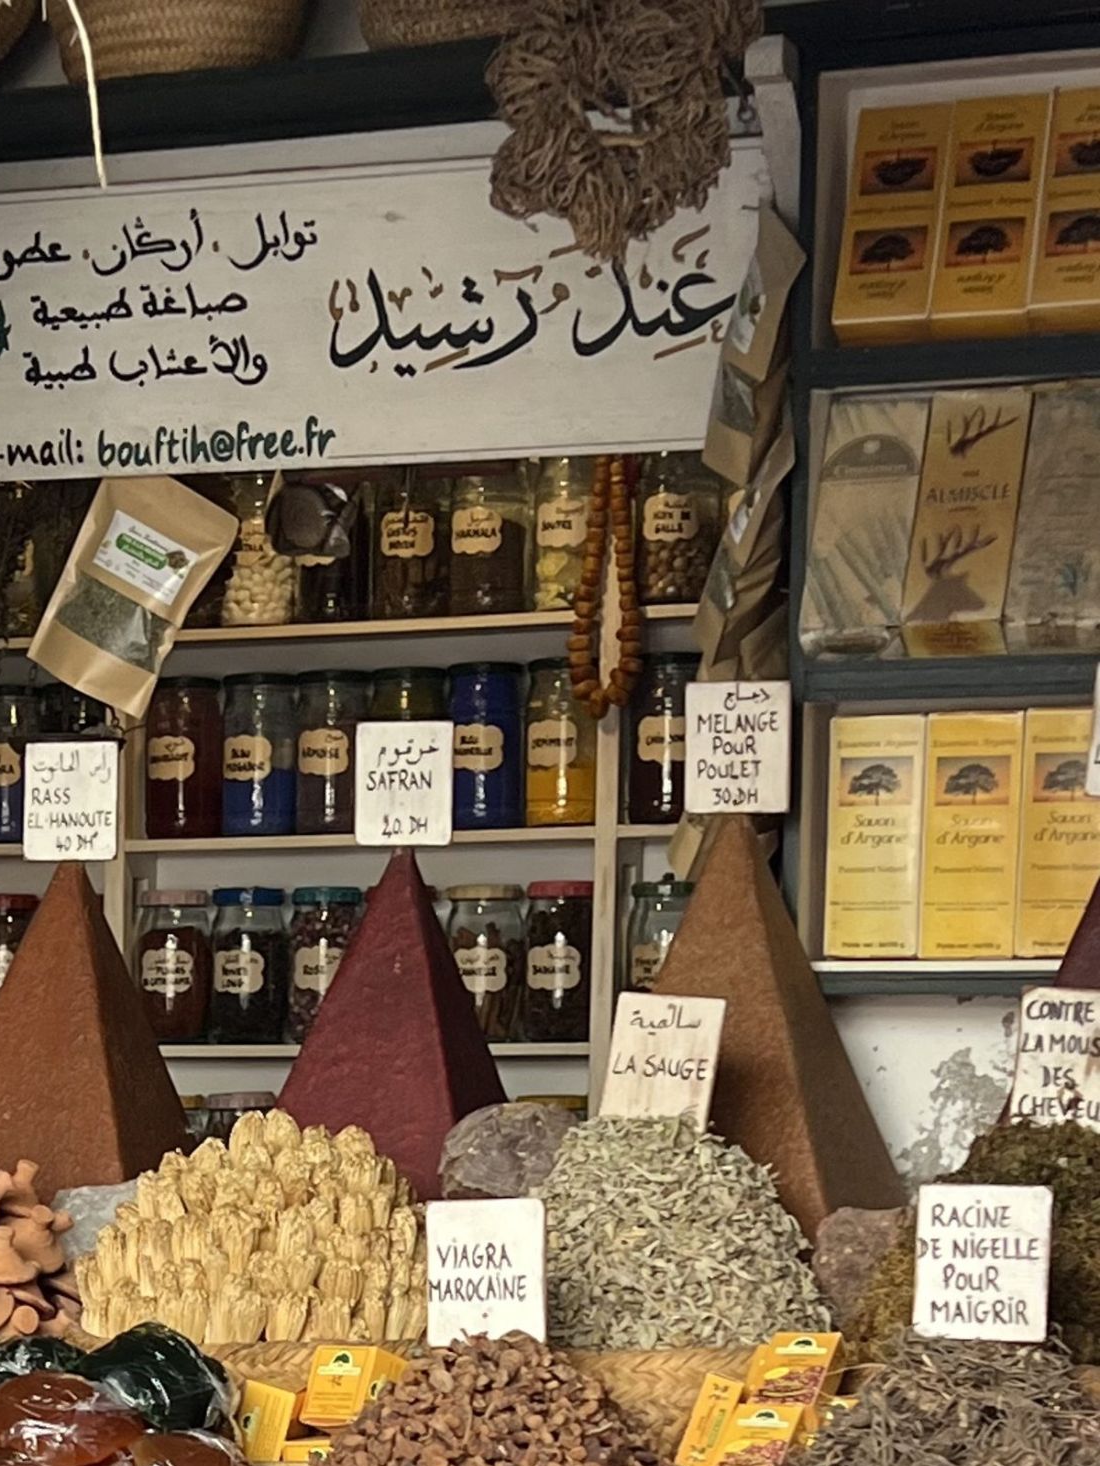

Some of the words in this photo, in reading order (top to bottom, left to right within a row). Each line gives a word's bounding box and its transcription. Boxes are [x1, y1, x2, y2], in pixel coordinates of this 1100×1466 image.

[228, 210, 318, 270] توابل
[30, 286, 134, 331] طبيعية
[140, 282, 248, 320] صباغة
[22, 345, 98, 390] طبية
[98, 414, 337, 468] bouftih@free.fr
[696, 710, 780, 734] MELANGE
[365, 768, 433, 792] SAFRAN
[696, 758, 762, 780] POULET
[31, 787, 72, 806] RASS
[1025, 1000, 1097, 1026] CONTRE
[1020, 1033, 1044, 1053] LA
[612, 1051, 637, 1075] LA
[642, 1054, 710, 1081] SAUGE
[1041, 1066, 1078, 1091] DES
[930, 1199, 1012, 1228] RACINE
[435, 1236, 513, 1271] VIAGRA
[916, 1237, 943, 1260] DE
[951, 1231, 1042, 1262] NIGELLE
[427, 1271, 528, 1303] MAROCAINE
[942, 1263, 1002, 1292] POUR
[929, 1294, 1030, 1326] MAIGRIR
